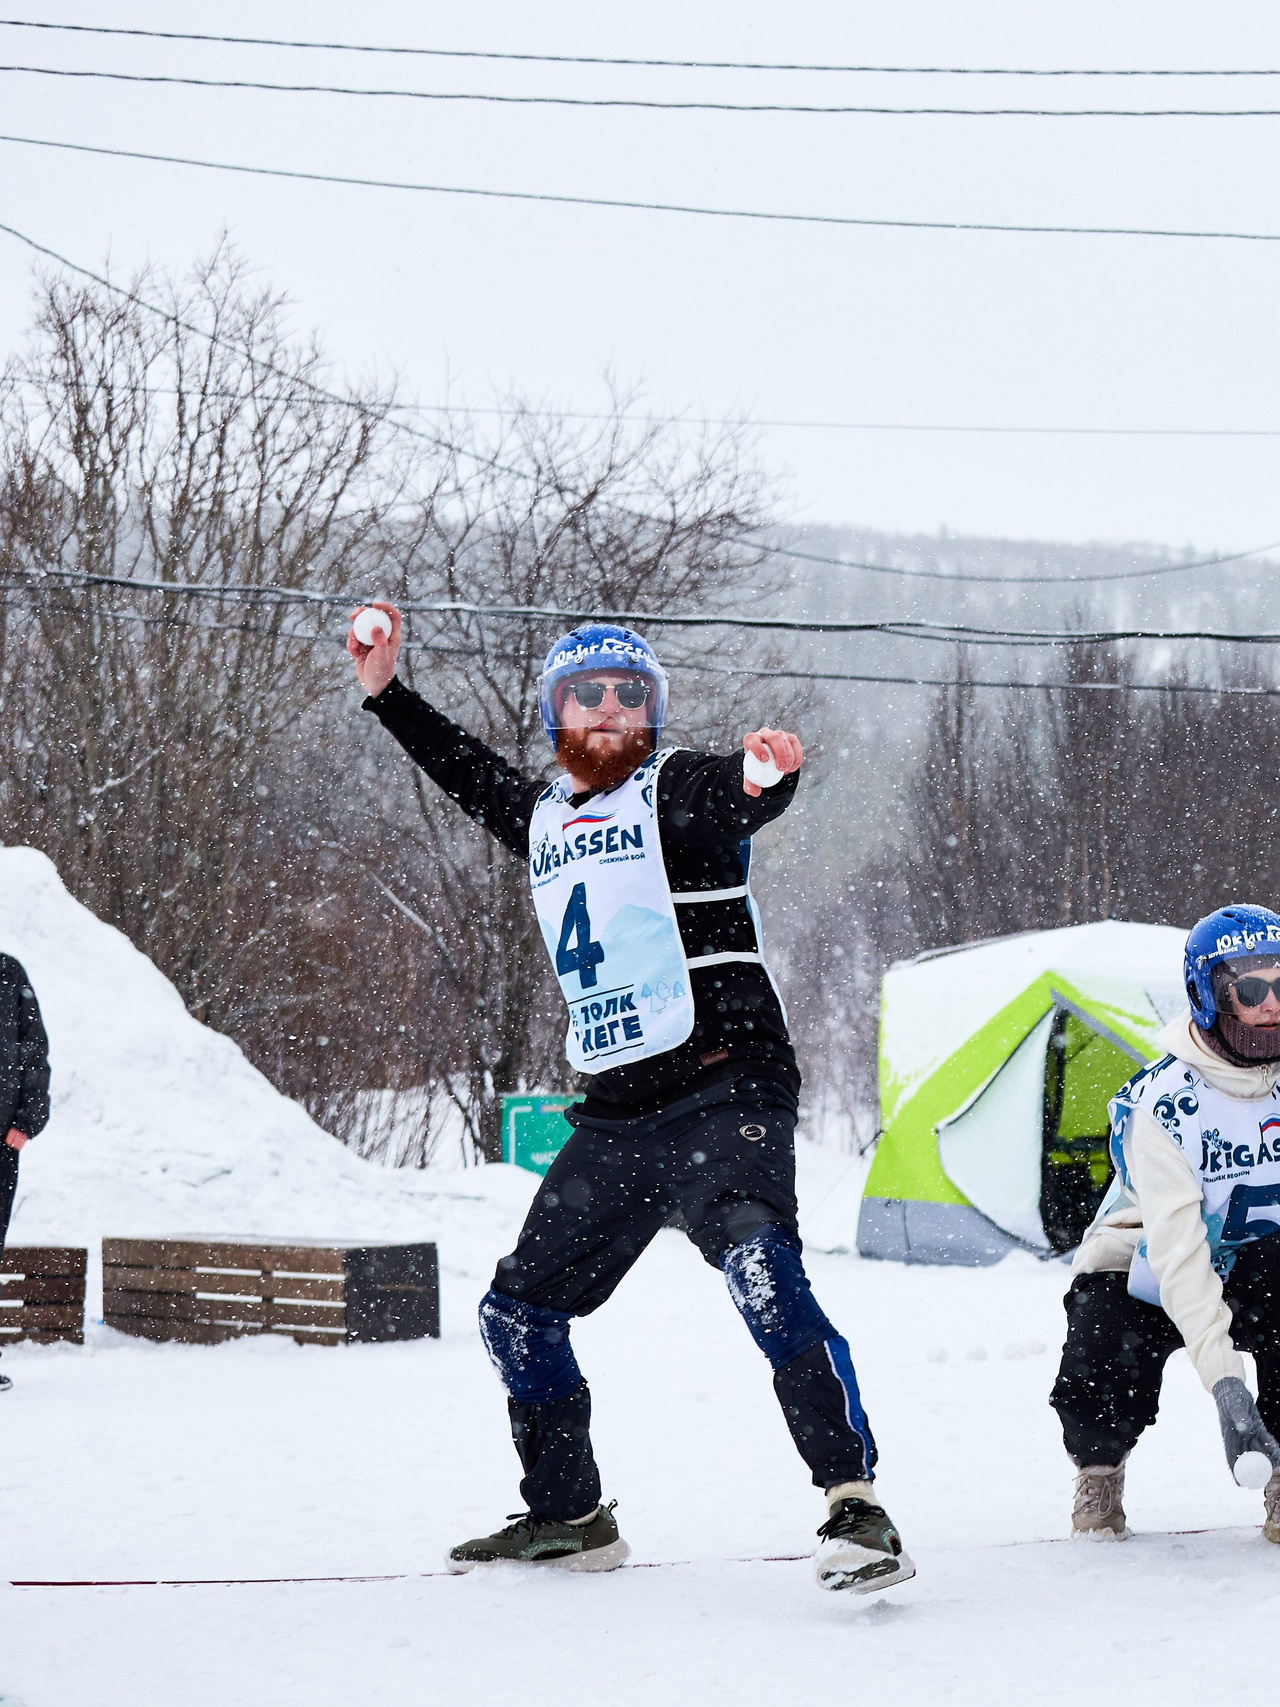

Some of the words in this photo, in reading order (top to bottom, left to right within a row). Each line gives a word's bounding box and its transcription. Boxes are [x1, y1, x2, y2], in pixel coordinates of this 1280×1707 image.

[599, 854, 630, 865] СНЕЖНЫЙ
[556, 881, 604, 989] 4
[580, 992, 637, 1024] ТОЛК
